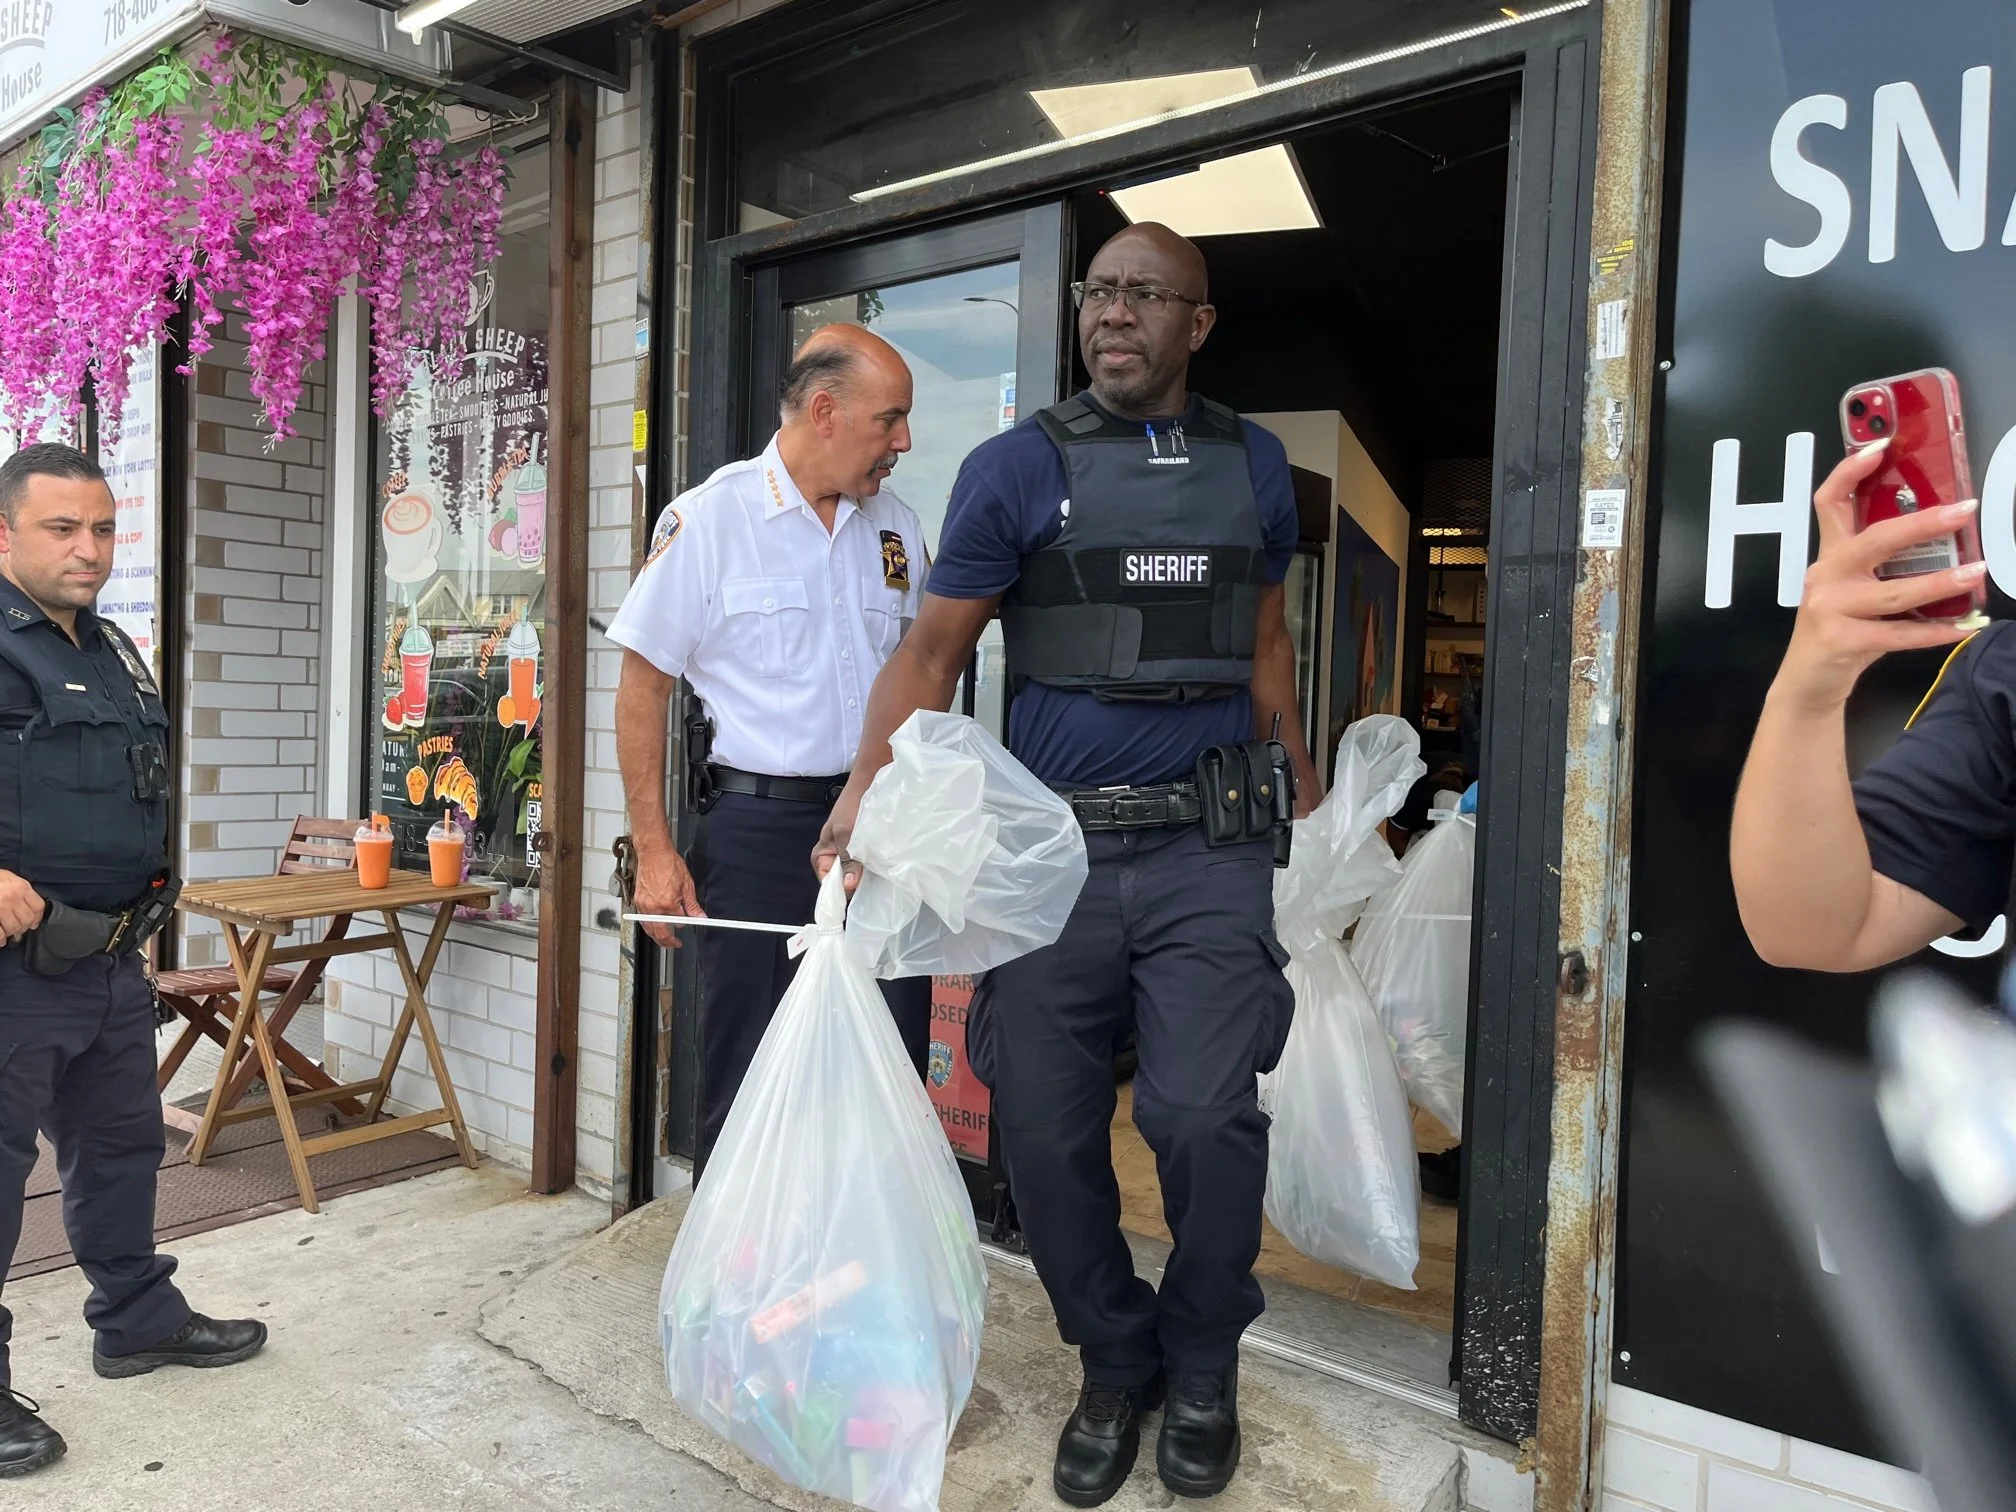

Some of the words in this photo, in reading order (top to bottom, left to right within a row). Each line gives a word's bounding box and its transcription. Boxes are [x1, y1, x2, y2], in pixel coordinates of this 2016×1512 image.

[1, 0, 53, 42] SHEEP
[2, 61, 42, 111] House
[1763, 65, 2016, 278] SN
[475, 328, 525, 357] SHEEP
[475, 369, 515, 393] House
[459, 398, 499, 418] SMOOTHIES
[505, 390, 539, 410] NATURAL
[440, 421, 473, 439] PASTRIES
[1125, 554, 1209, 582] SHERIFF
[478, 629, 500, 679] NATURAL
[417, 736, 454, 759] PASTRIES
[929, 1042, 951, 1055] HERIFF
